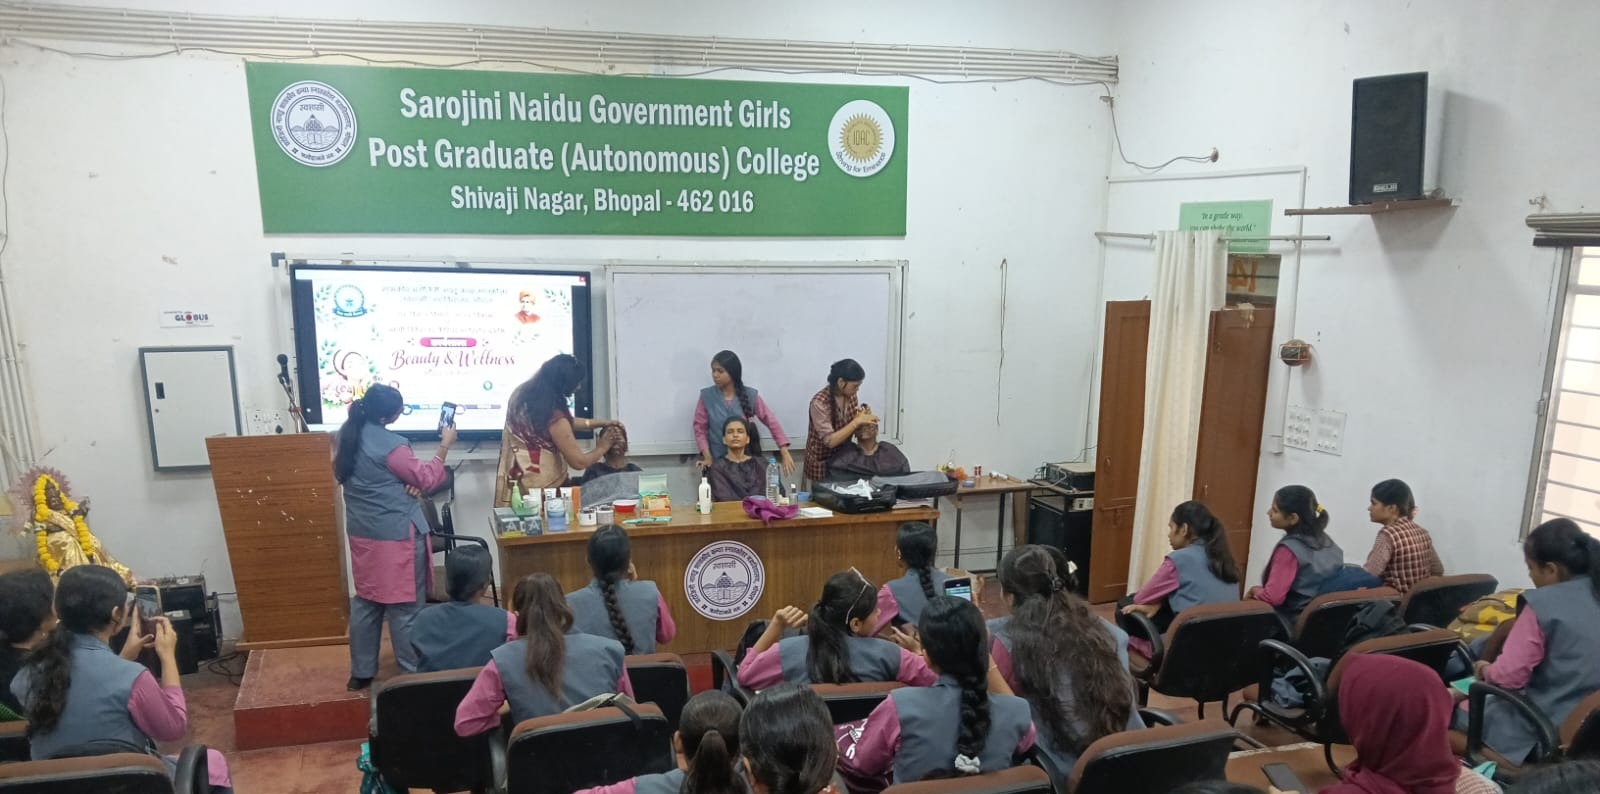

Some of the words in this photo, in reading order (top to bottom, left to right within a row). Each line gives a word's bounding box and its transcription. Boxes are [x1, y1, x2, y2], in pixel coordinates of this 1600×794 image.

[400, 88, 502, 127] Sarojini
[509, 92, 582, 123] Naidu
[590, 95, 733, 128] Government
[739, 99, 791, 129] Girls
[368, 137, 429, 168] Post
[435, 139, 554, 171] Graduate
[562, 142, 730, 180] (Autonomous)
[737, 147, 820, 182] College
[451, 185, 519, 215] Shivaji
[524, 187, 588, 216] Nagar,
[594, 189, 661, 217] Bhopal
[677, 190, 714, 212] 462
[719, 191, 754, 213] 016
[388, 350, 440, 371] Beauty
[443, 351, 454, 366] &
[459, 350, 516, 368] Wellness
